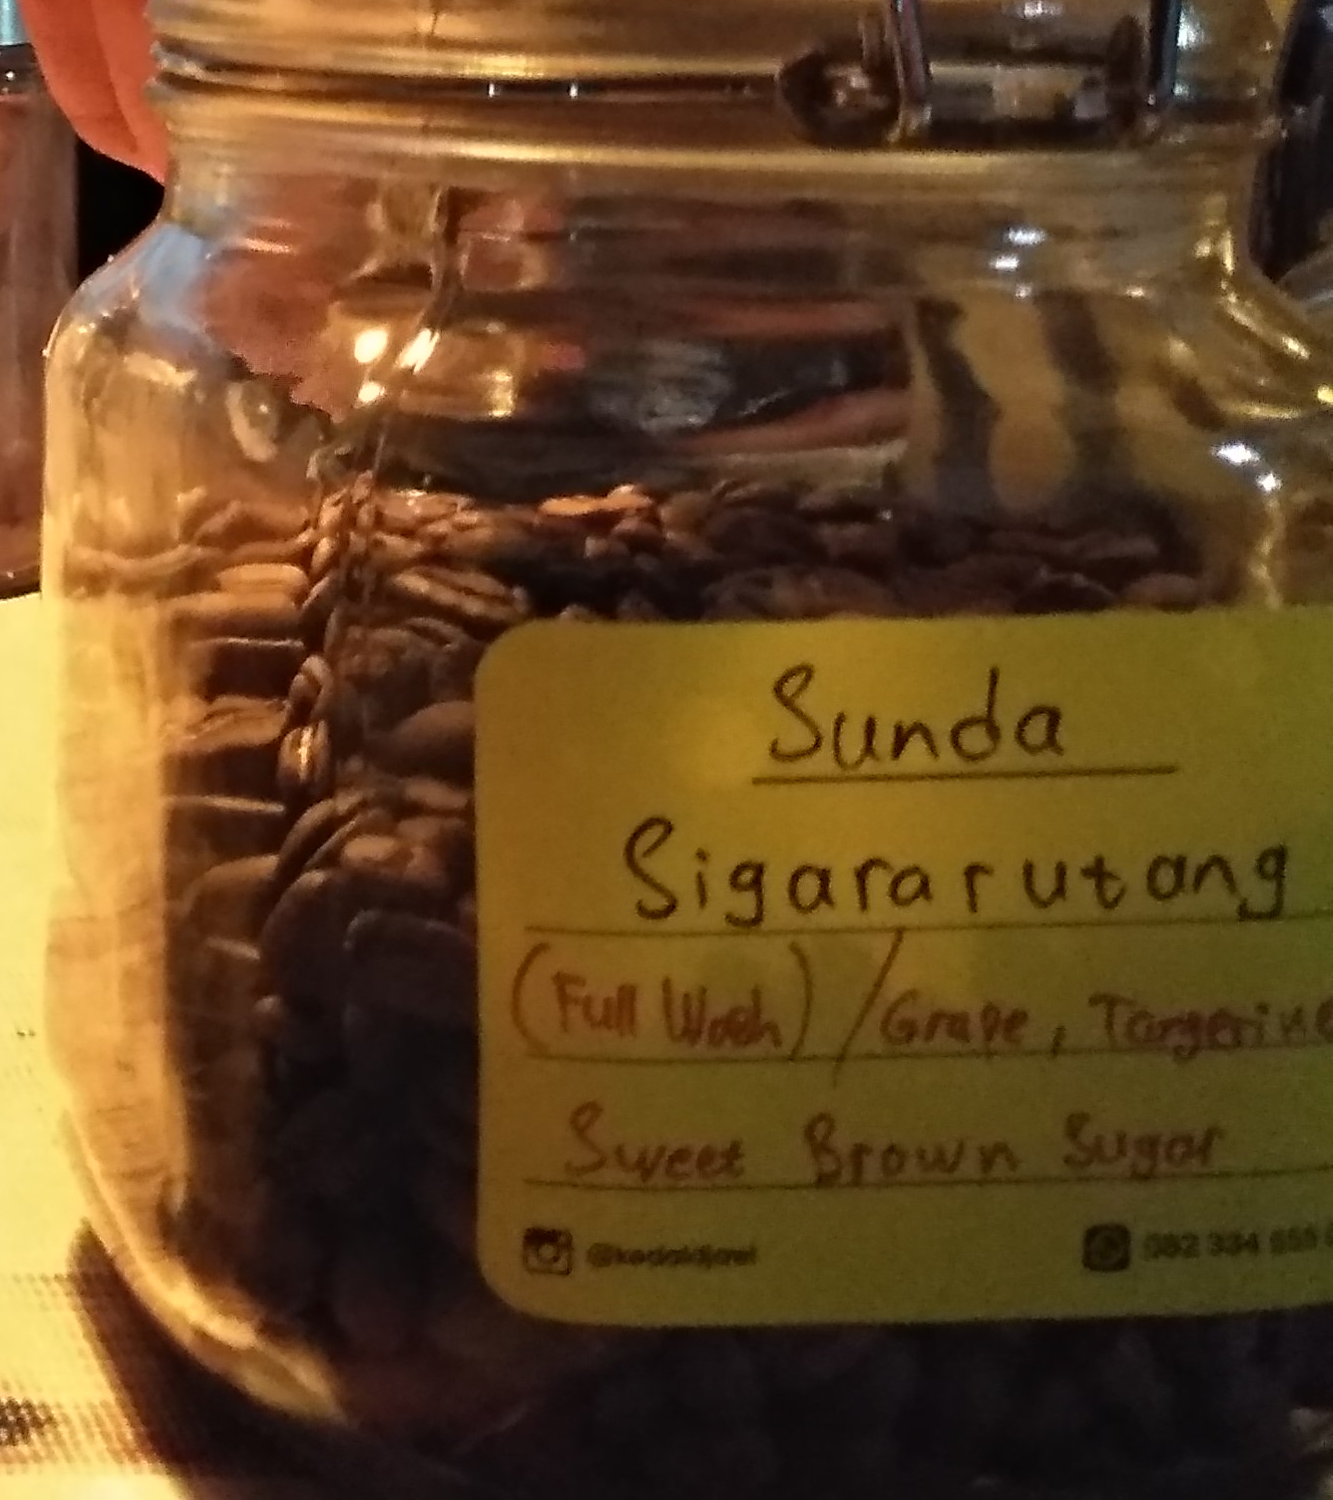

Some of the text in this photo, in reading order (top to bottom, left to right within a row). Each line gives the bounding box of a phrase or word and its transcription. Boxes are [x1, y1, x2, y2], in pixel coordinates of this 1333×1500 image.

[768, 662, 1065, 773] Sunda
[622, 815, 1292, 930] Sigararutang
[564, 1100, 1227, 1190] Sweet Brown Sugar
